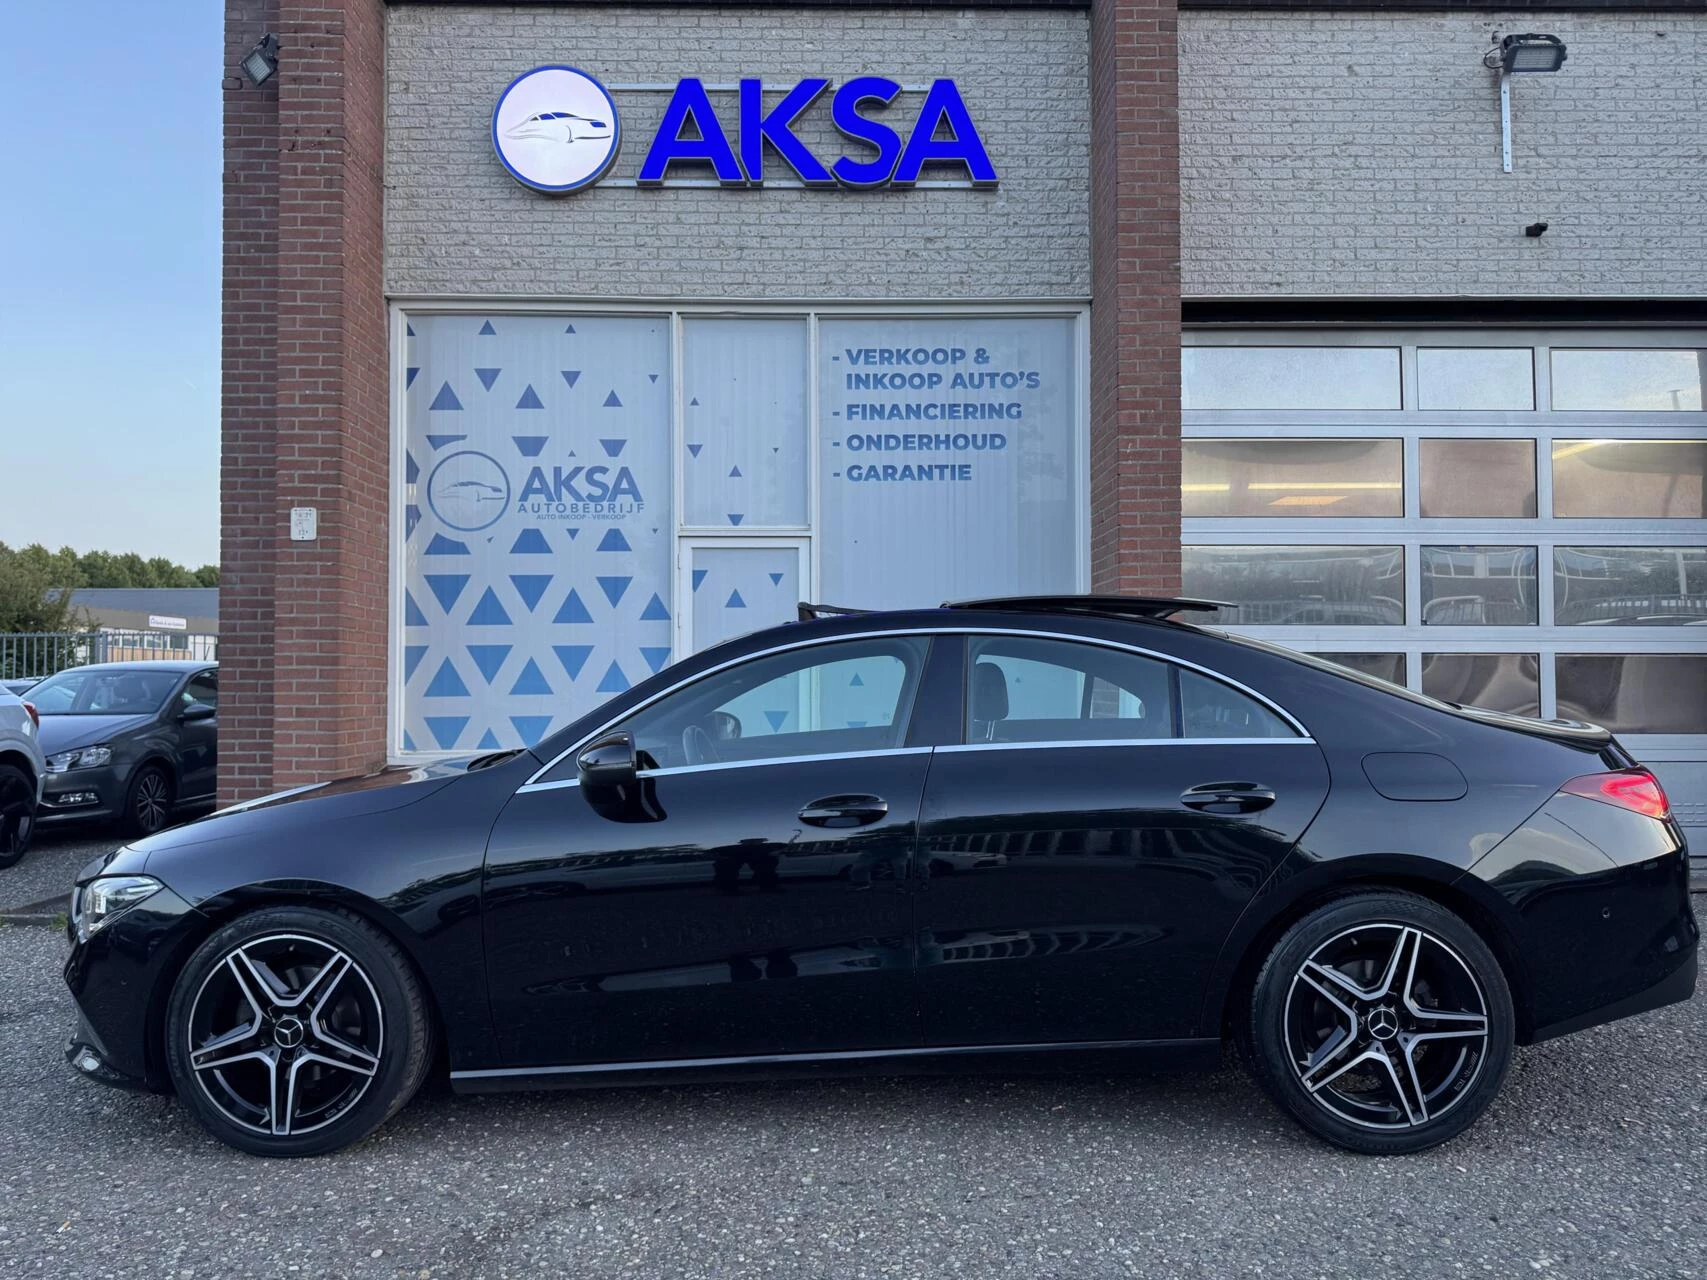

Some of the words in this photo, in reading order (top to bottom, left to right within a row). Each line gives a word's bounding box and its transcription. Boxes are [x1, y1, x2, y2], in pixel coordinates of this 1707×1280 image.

[636, 76, 999, 190] AKSA
[845, 348, 966, 366] VERKOOP
[973, 347, 991, 365] &
[846, 372, 943, 390] INKOOP
[950, 371, 1041, 389] AUTO'S
[846, 402, 1023, 421] FINANCIERING
[846, 433, 1007, 451] ONDERHOUD
[846, 464, 972, 482] GARANTIE
[518, 465, 644, 503] AKSA
[517, 503, 645, 514] AUTOBEDRIJF
